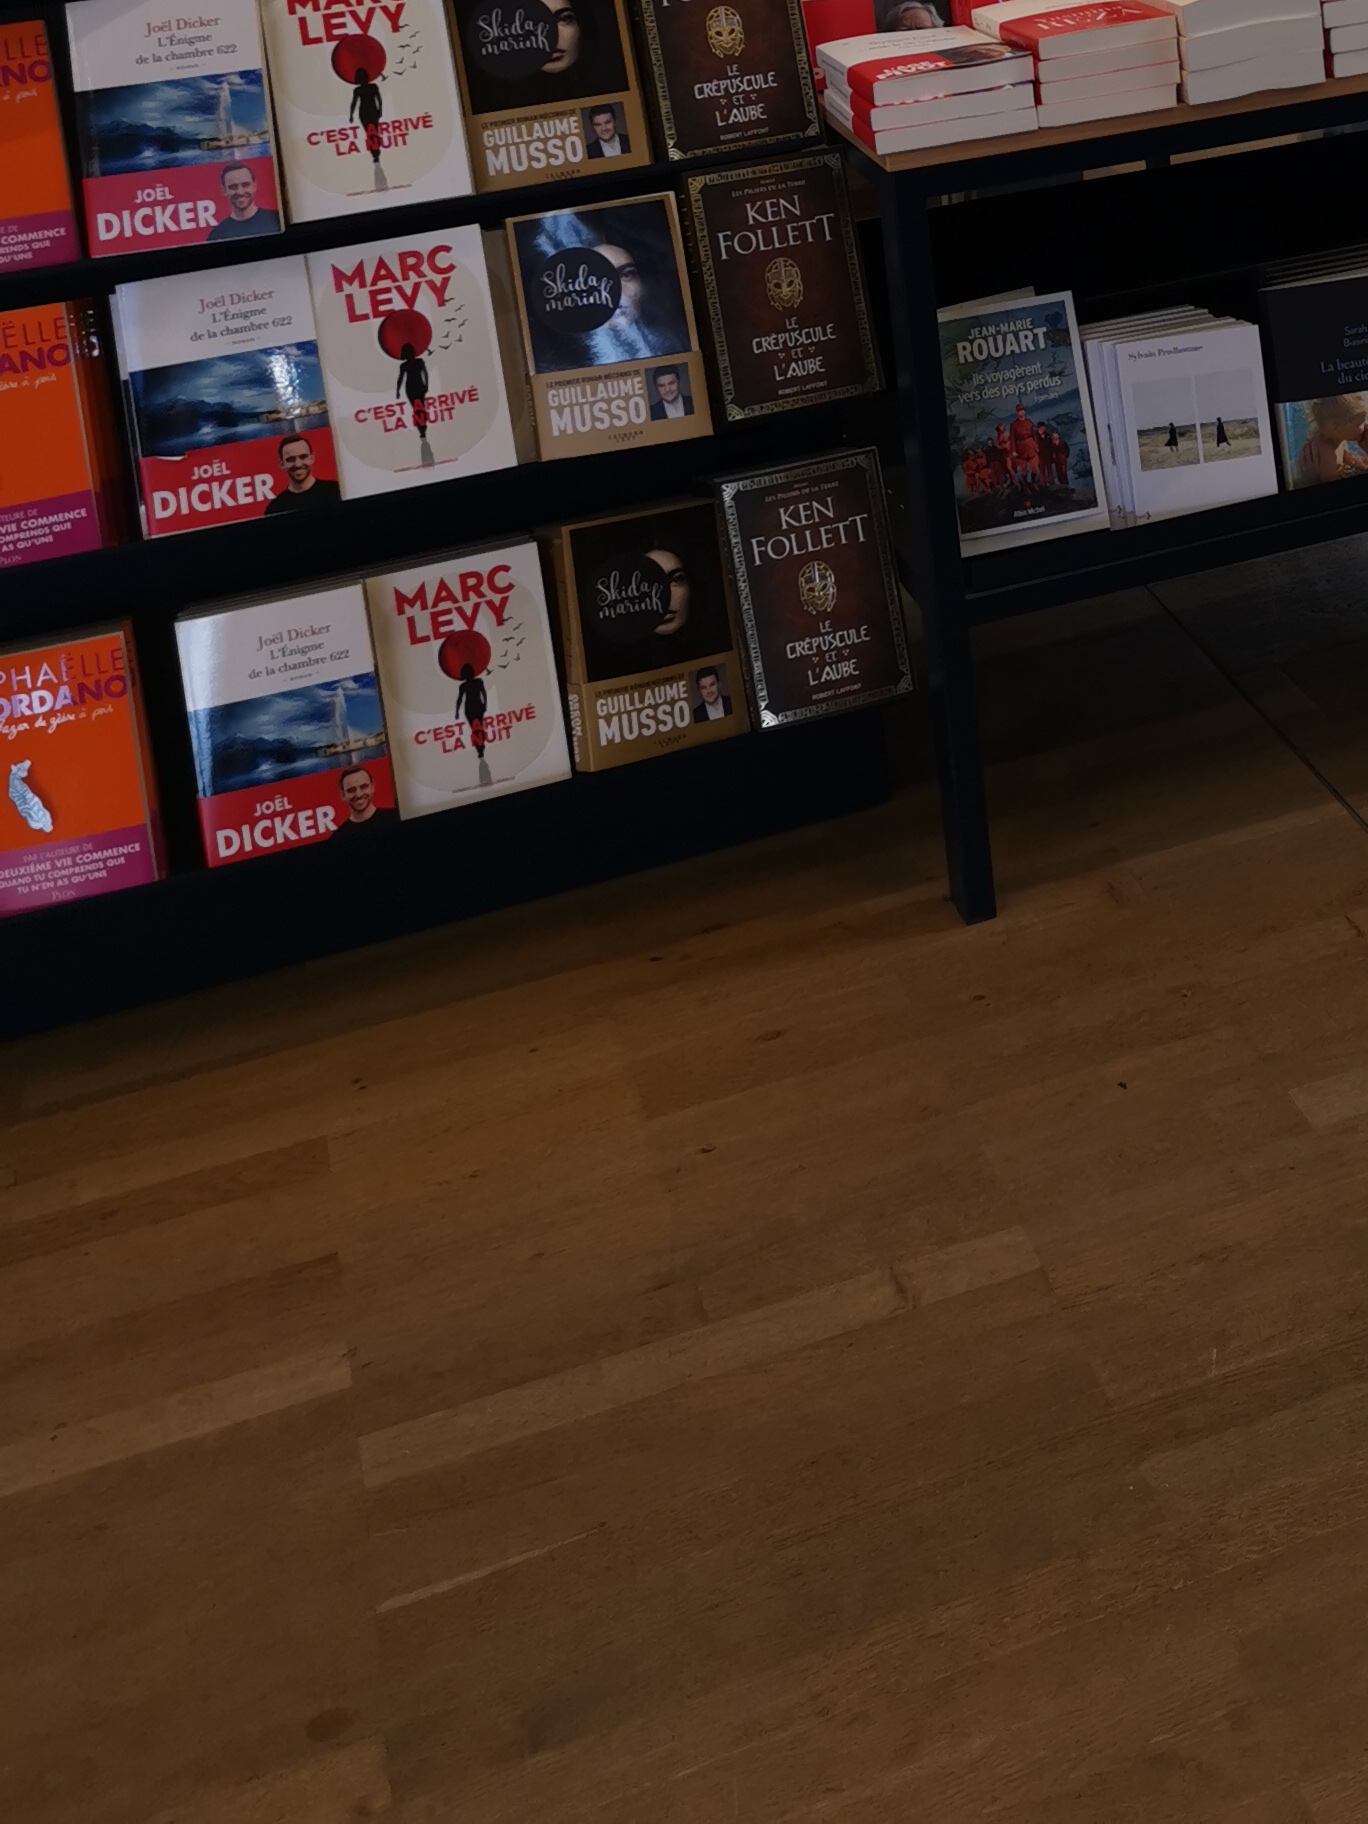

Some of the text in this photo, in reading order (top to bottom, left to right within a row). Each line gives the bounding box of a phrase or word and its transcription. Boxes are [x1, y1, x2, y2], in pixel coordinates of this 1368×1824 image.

[298, 3, 406, 45] LEVY
[726, 64, 740, 76] LE
[483, 117, 580, 148] GUILLAUME
[715, 105, 768, 127] L'AUBE
[485, 140, 583, 176] MUSSO
[134, 182, 174, 204] JOËL
[744, 195, 801, 226] KEN
[96, 199, 219, 241] DICKER
[716, 213, 835, 260] FOLLETT
[331, 245, 457, 293] MARC
[344, 276, 451, 323] LEVY
[956, 327, 1047, 364] ROUART
[968, 318, 1033, 340] JEAN-MARIE
[1320, 361, 1334, 373] La
[1338, 372, 1352, 384] du
[548, 376, 644, 408] GUILLAUME
[549, 400, 646, 437] MUSSO
[191, 458, 231, 480] JOËL
[152, 472, 276, 520] DICKER
[779, 496, 834, 530] KEN
[750, 514, 868, 567] FOLLETT
[393, 564, 515, 617] MARC
[287, 622, 332, 647] Dicker
[406, 595, 510, 645] LEVY
[278, 654, 327, 673] chambre
[595, 680, 688, 717] GUILLAUME
[597, 702, 691, 746] MUSSO
[253, 794, 292, 817] JOËL
[215, 804, 338, 859] DICKER
